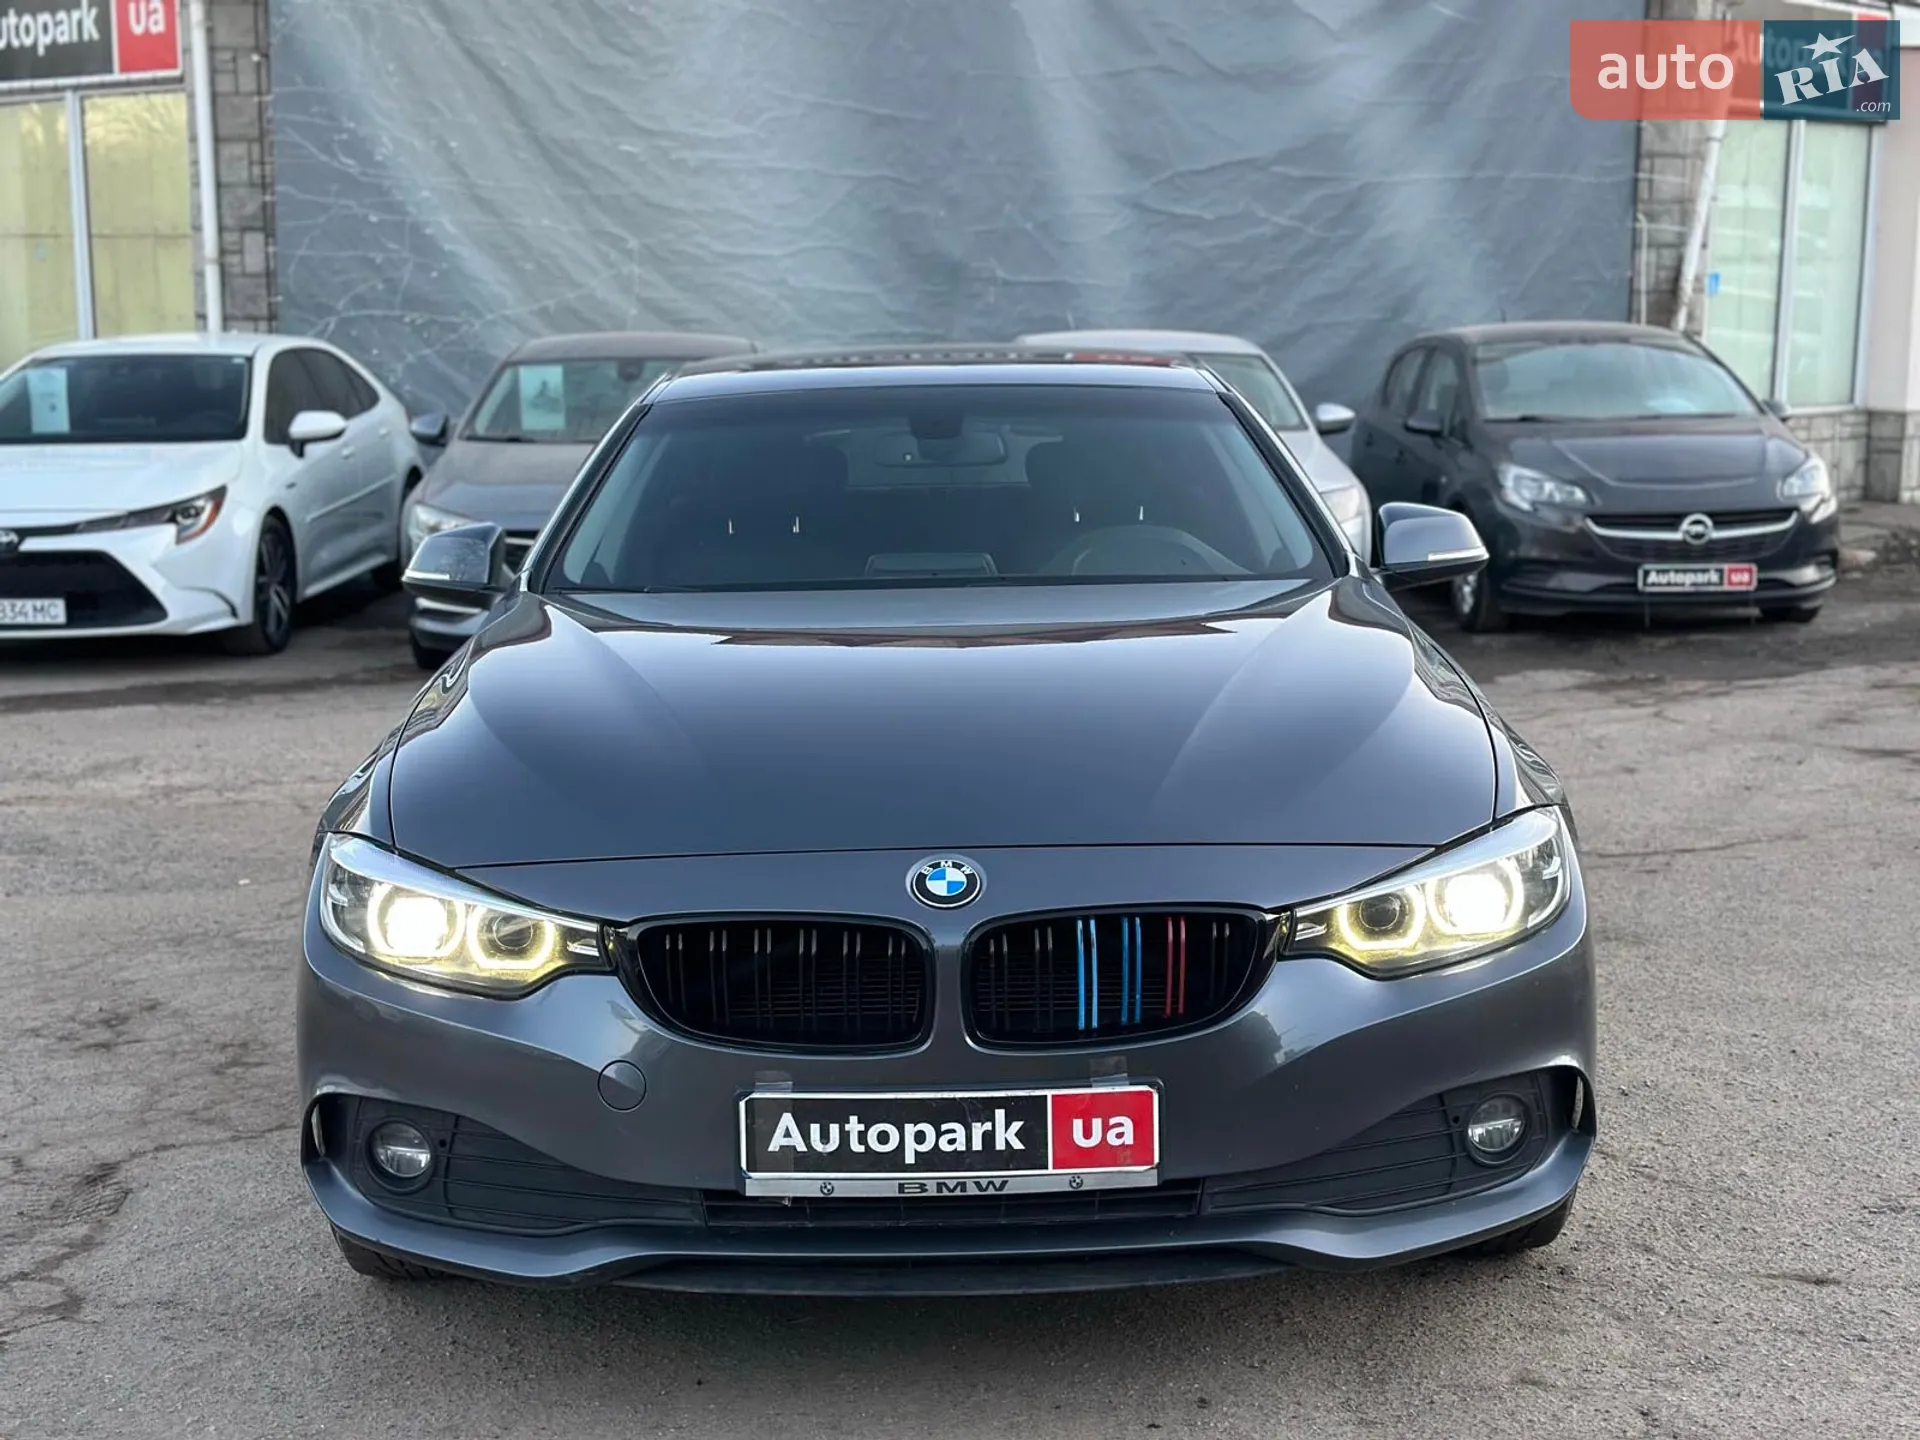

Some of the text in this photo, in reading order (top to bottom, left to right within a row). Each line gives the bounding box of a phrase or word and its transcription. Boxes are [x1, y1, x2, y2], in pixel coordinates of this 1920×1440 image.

[128, 0, 166, 35] ua
[1646, 568, 1751, 588] Autopark ua
[767, 1108, 1135, 1165] Autopark ua
[897, 1179, 1010, 1195] BMW
